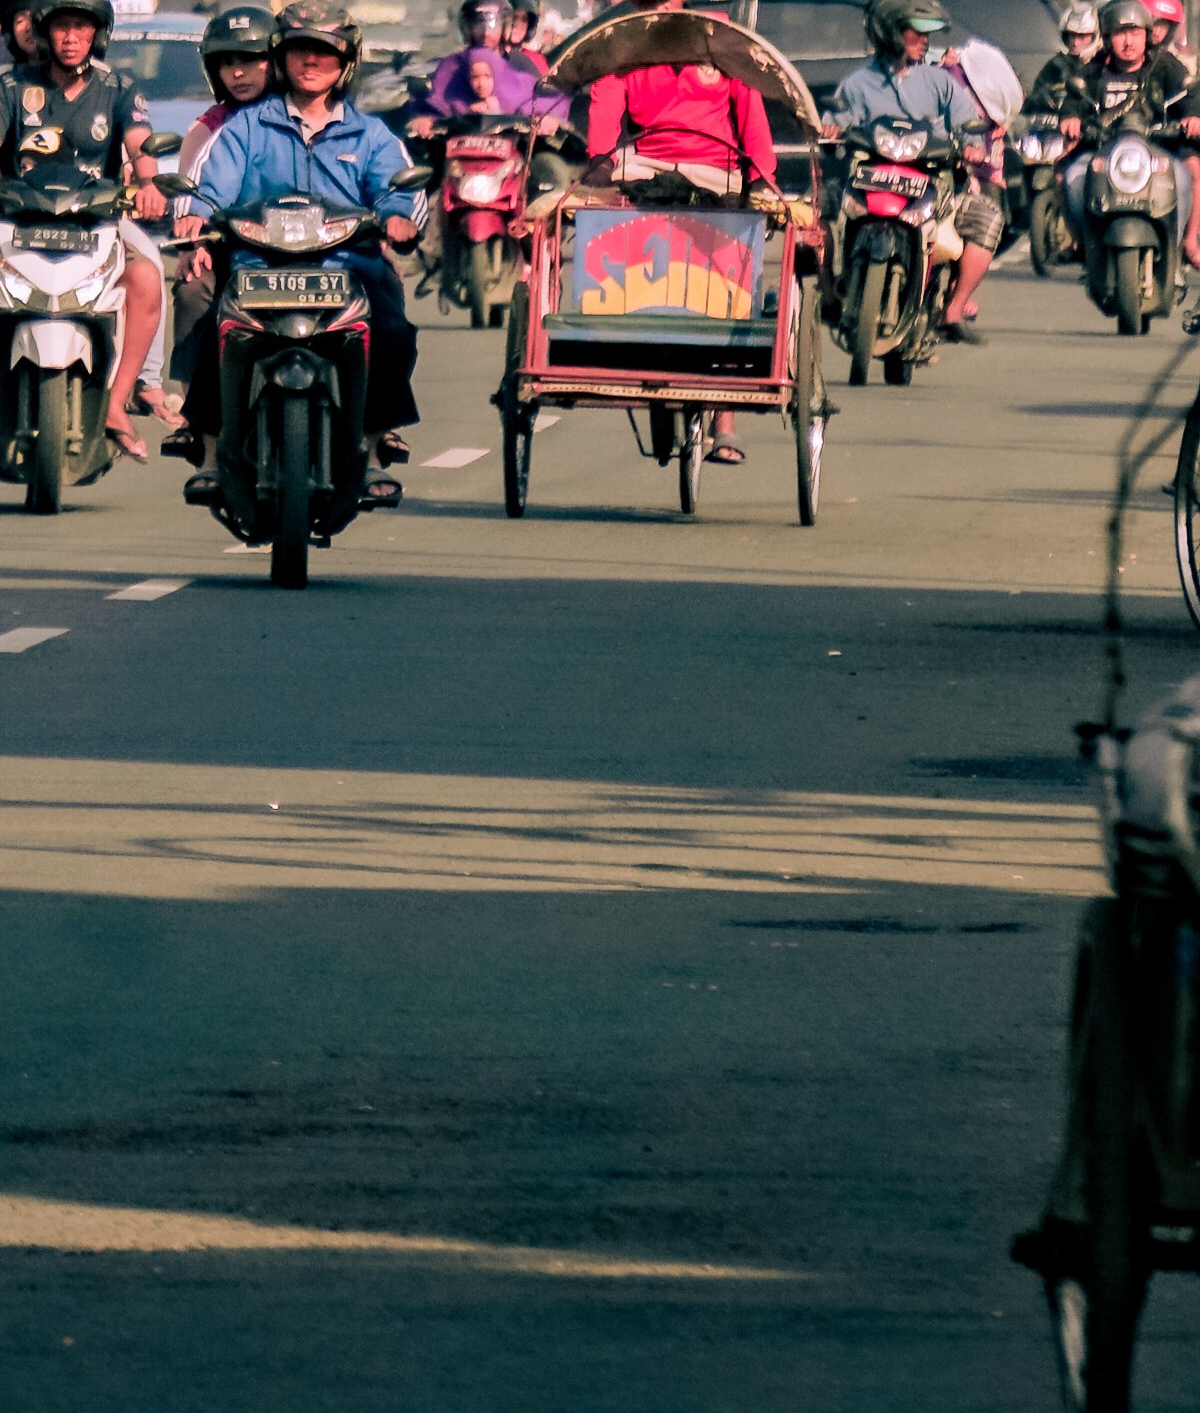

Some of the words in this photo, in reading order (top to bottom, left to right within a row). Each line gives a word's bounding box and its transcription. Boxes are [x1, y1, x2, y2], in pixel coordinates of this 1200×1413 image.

[245, 277, 254, 291] L
[268, 276, 306, 291] 5109
[320, 276, 339, 291] SY
